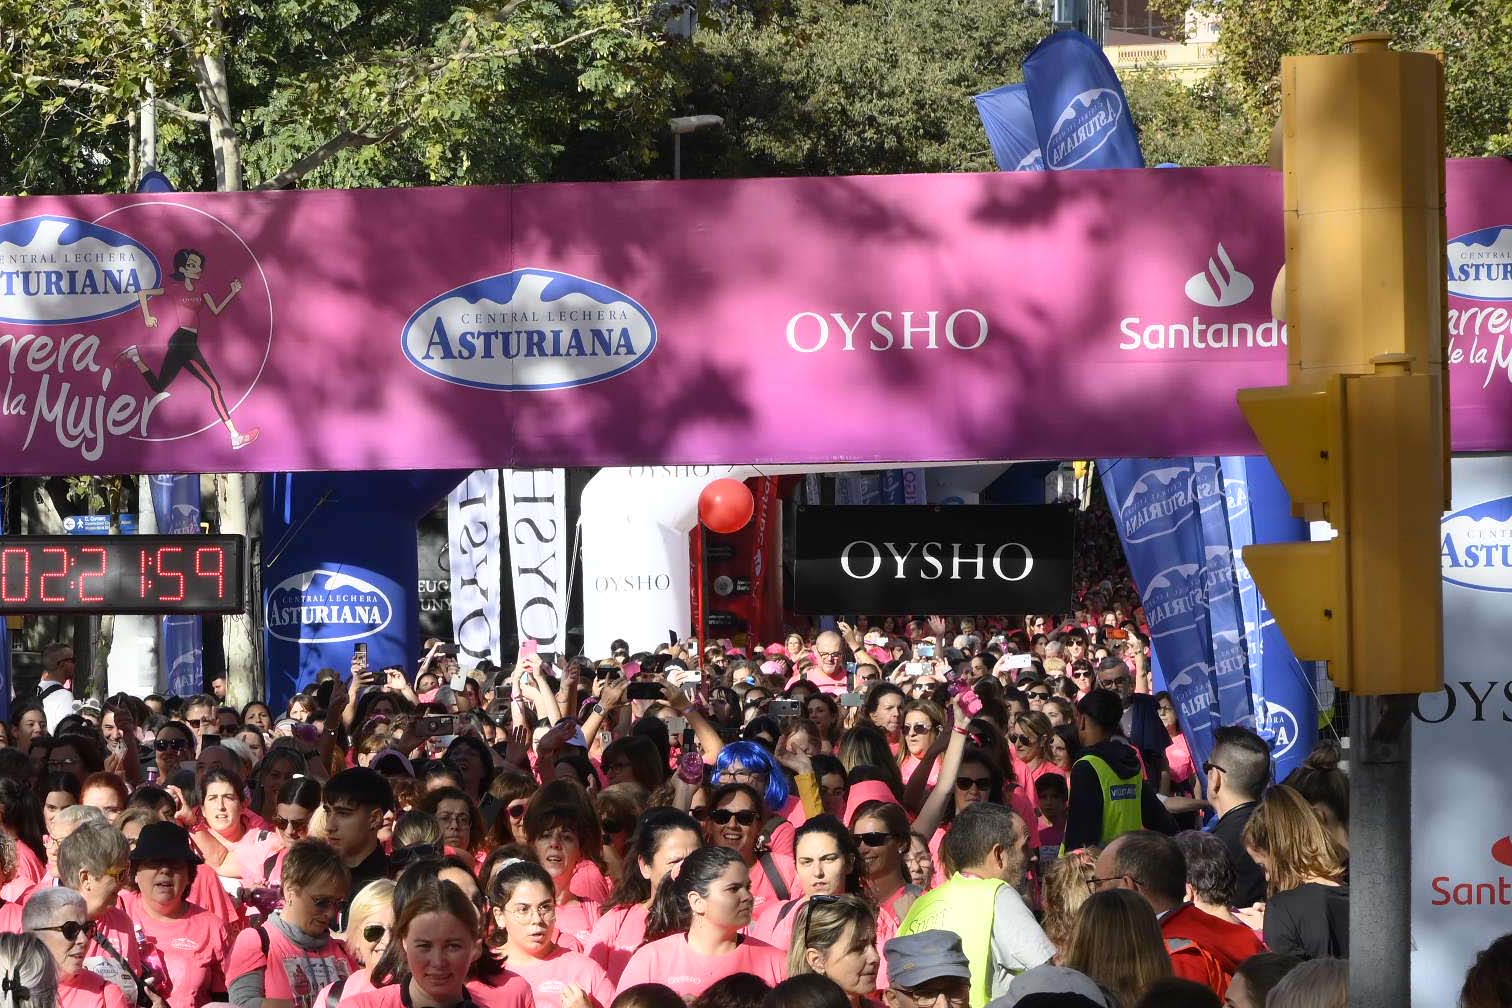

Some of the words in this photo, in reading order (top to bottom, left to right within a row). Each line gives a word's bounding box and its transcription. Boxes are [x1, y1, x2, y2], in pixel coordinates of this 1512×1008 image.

[64, 250, 136, 263] LECHERA
[461, 311, 541, 324] CENTRAL
[547, 308, 628, 323] LECHERA
[786, 307, 989, 353] OYSHO
[421, 316, 637, 361] ASTURIANA
[1119, 316, 1288, 351] Santand
[1470, 336, 1487, 364] la
[2, 378, 26, 416] la
[22, 367, 170, 462] Mujer
[840, 540, 1034, 581] OYSHO
[594, 574, 671, 592] OYSHO
[269, 598, 382, 628] ASTURIANA
[320, 594, 377, 603] LECHERA
